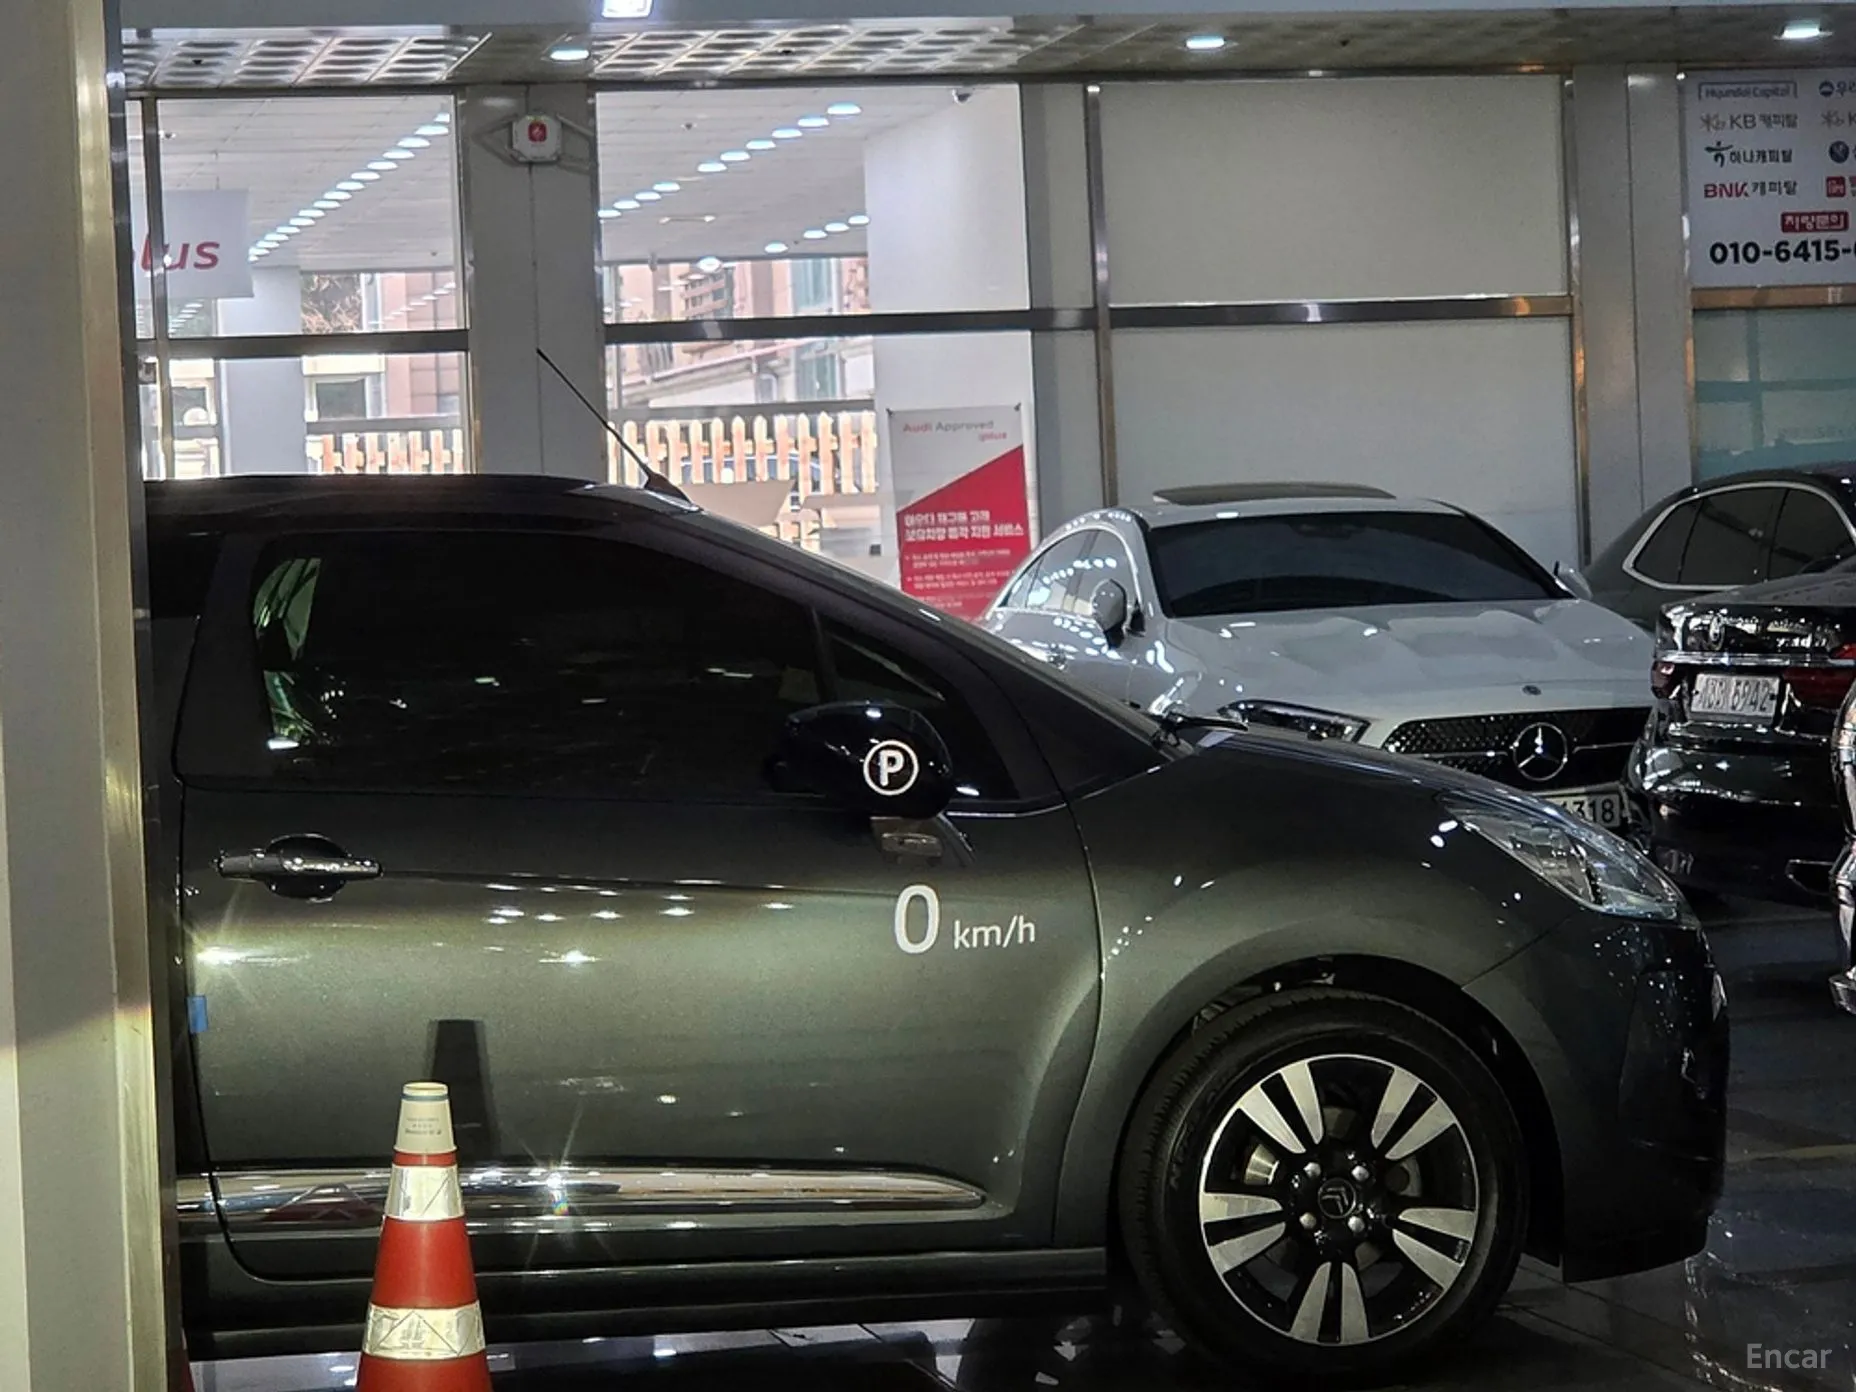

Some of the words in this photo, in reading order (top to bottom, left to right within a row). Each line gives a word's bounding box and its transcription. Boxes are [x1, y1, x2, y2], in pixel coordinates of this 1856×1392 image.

[1729, 114, 1757, 129] KB
[1704, 182, 1749, 198] BNK
[1709, 239, 1856, 265] 010-6415-
[903, 422, 932, 433] Audi
[935, 420, 994, 432] Approved
[878, 748, 905, 787] P
[894, 884, 940, 954] 0
[954, 914, 1036, 949] km/h
